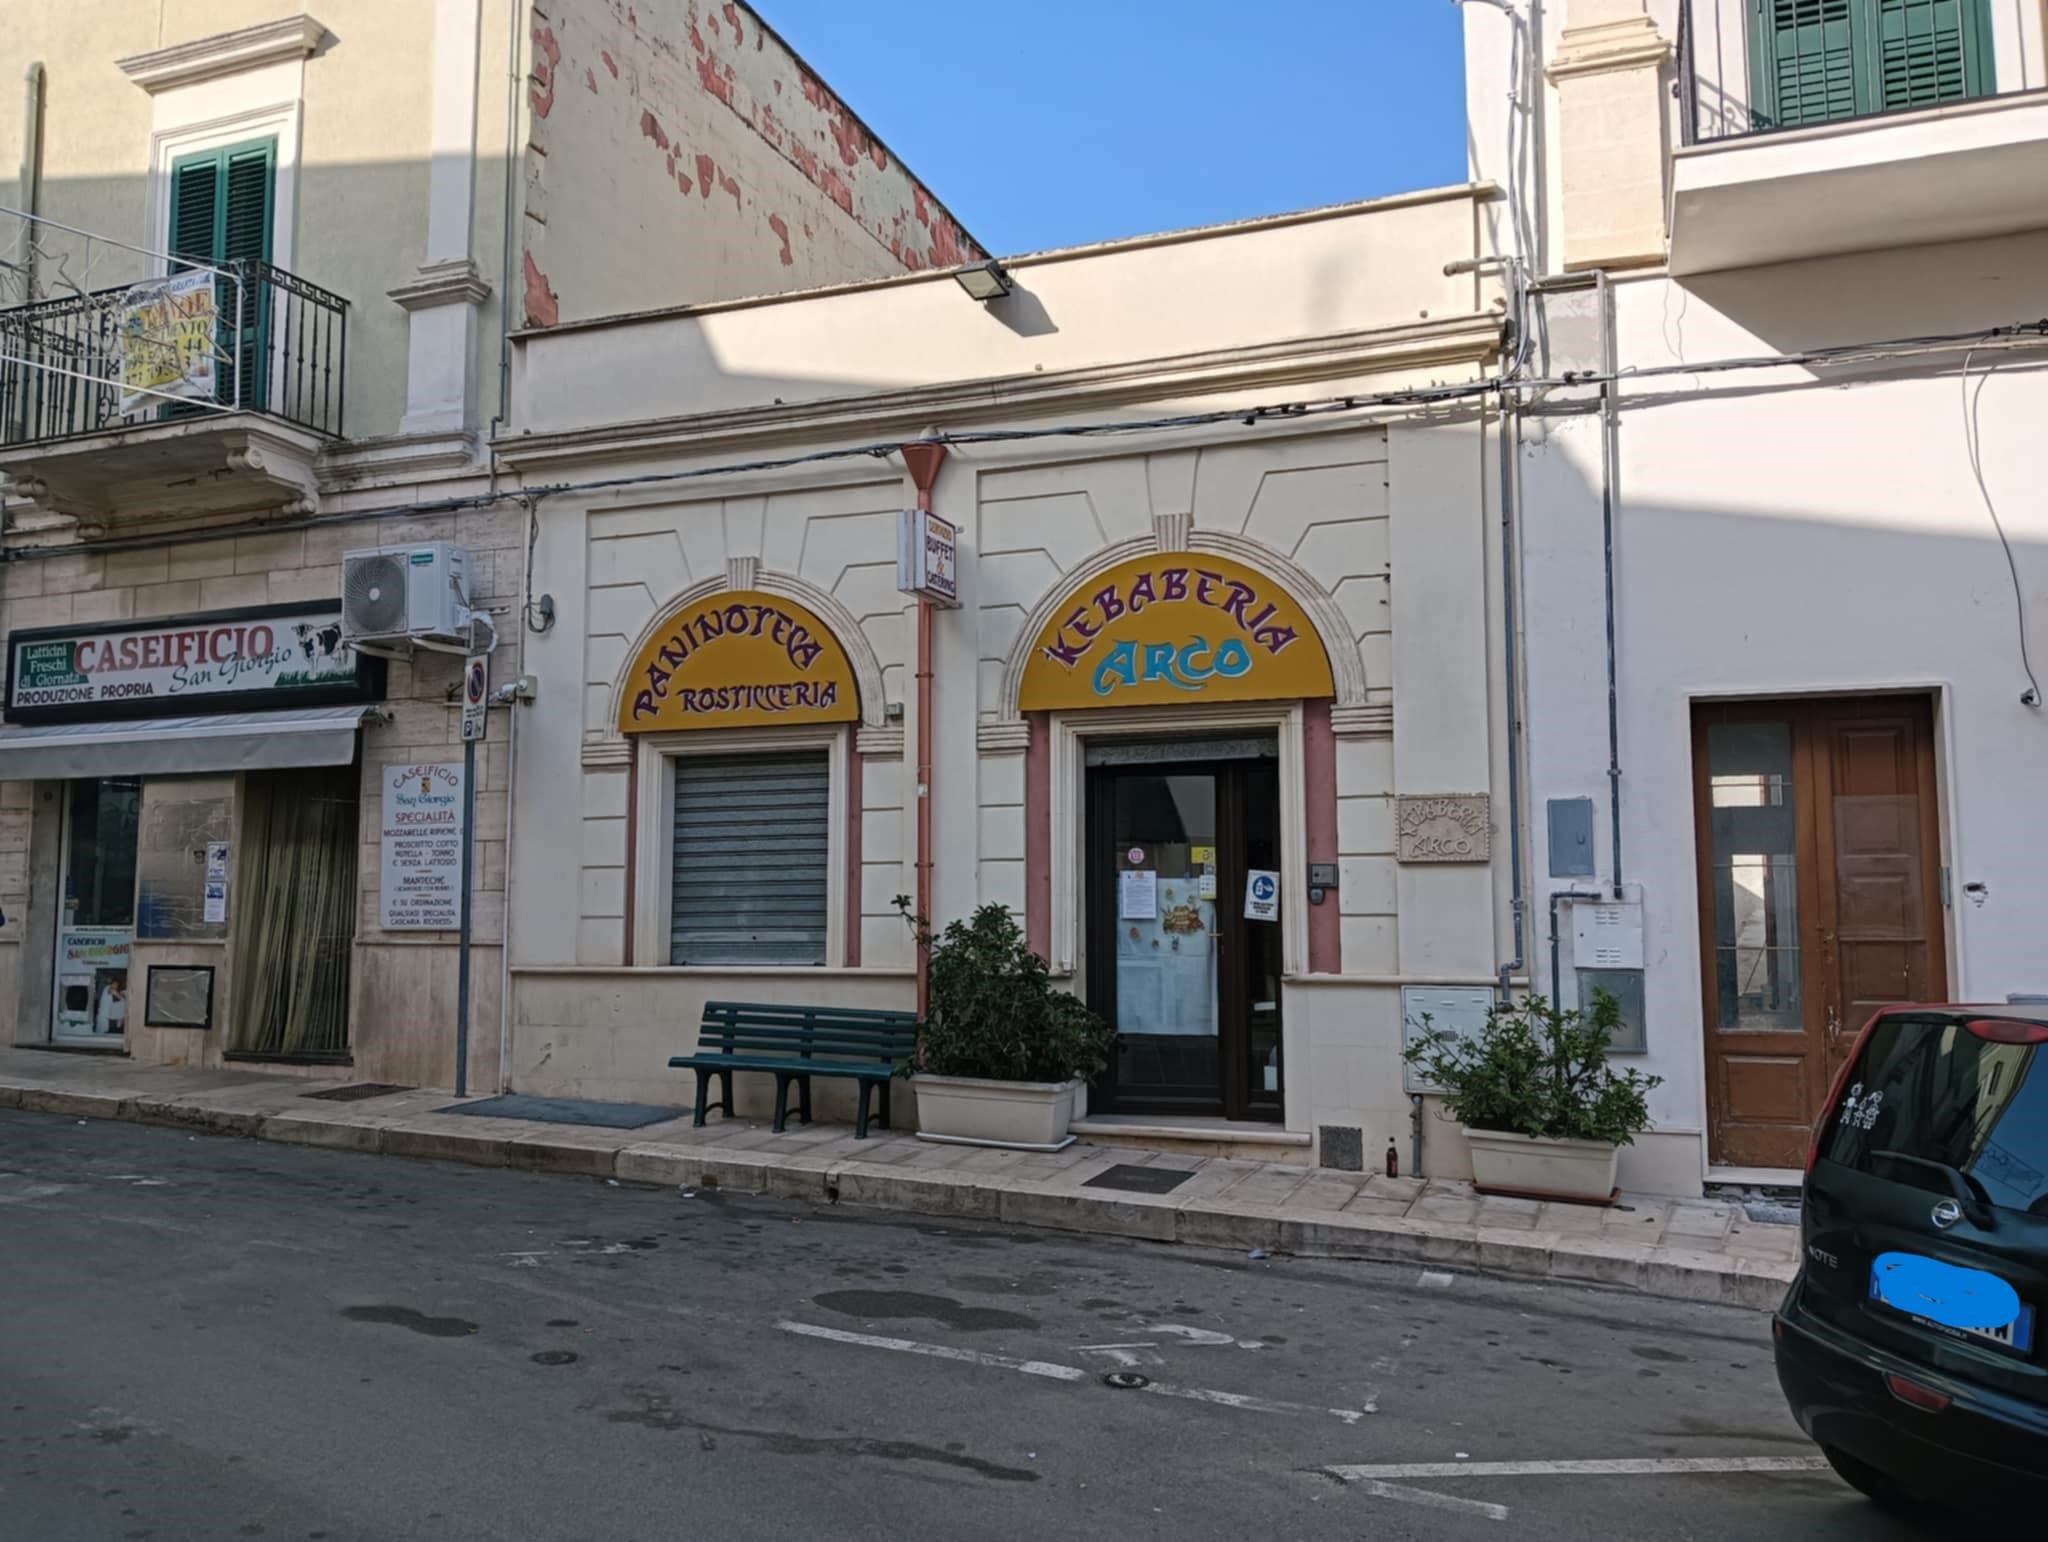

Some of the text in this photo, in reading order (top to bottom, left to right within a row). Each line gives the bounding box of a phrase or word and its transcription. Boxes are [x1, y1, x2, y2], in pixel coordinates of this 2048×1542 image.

[927, 535, 954, 562] BUFFET
[927, 570, 955, 594] CATERING
[1042, 568, 1298, 667] KEBABERIA
[26, 645, 68, 659] Latticini
[73, 625, 275, 675] CASEIFICIO
[30, 659, 67, 673] Freschi
[169, 647, 292, 693] San Giorgio
[633, 604, 823, 721] PANINOTECA
[1093, 635, 1251, 696] ARCO
[20, 672, 79, 688] di Giornata
[16, 682, 155, 705] PRODUZIONE PROPRIA
[677, 681, 838, 713] ROSTICCERIA
[393, 765, 459, 789] CASEIFICIO
[384, 828, 428, 838] MOZZARELLE
[395, 839, 459, 849] PROSCIUTTO COTTO
[431, 849, 455, 858] TONNO
[1409, 837, 1472, 858] ARCO
[400, 858, 422, 867] SENZA
[424, 857, 457, 867] LATTOSIO
[410, 898, 453, 907] ORDINAZIONE
